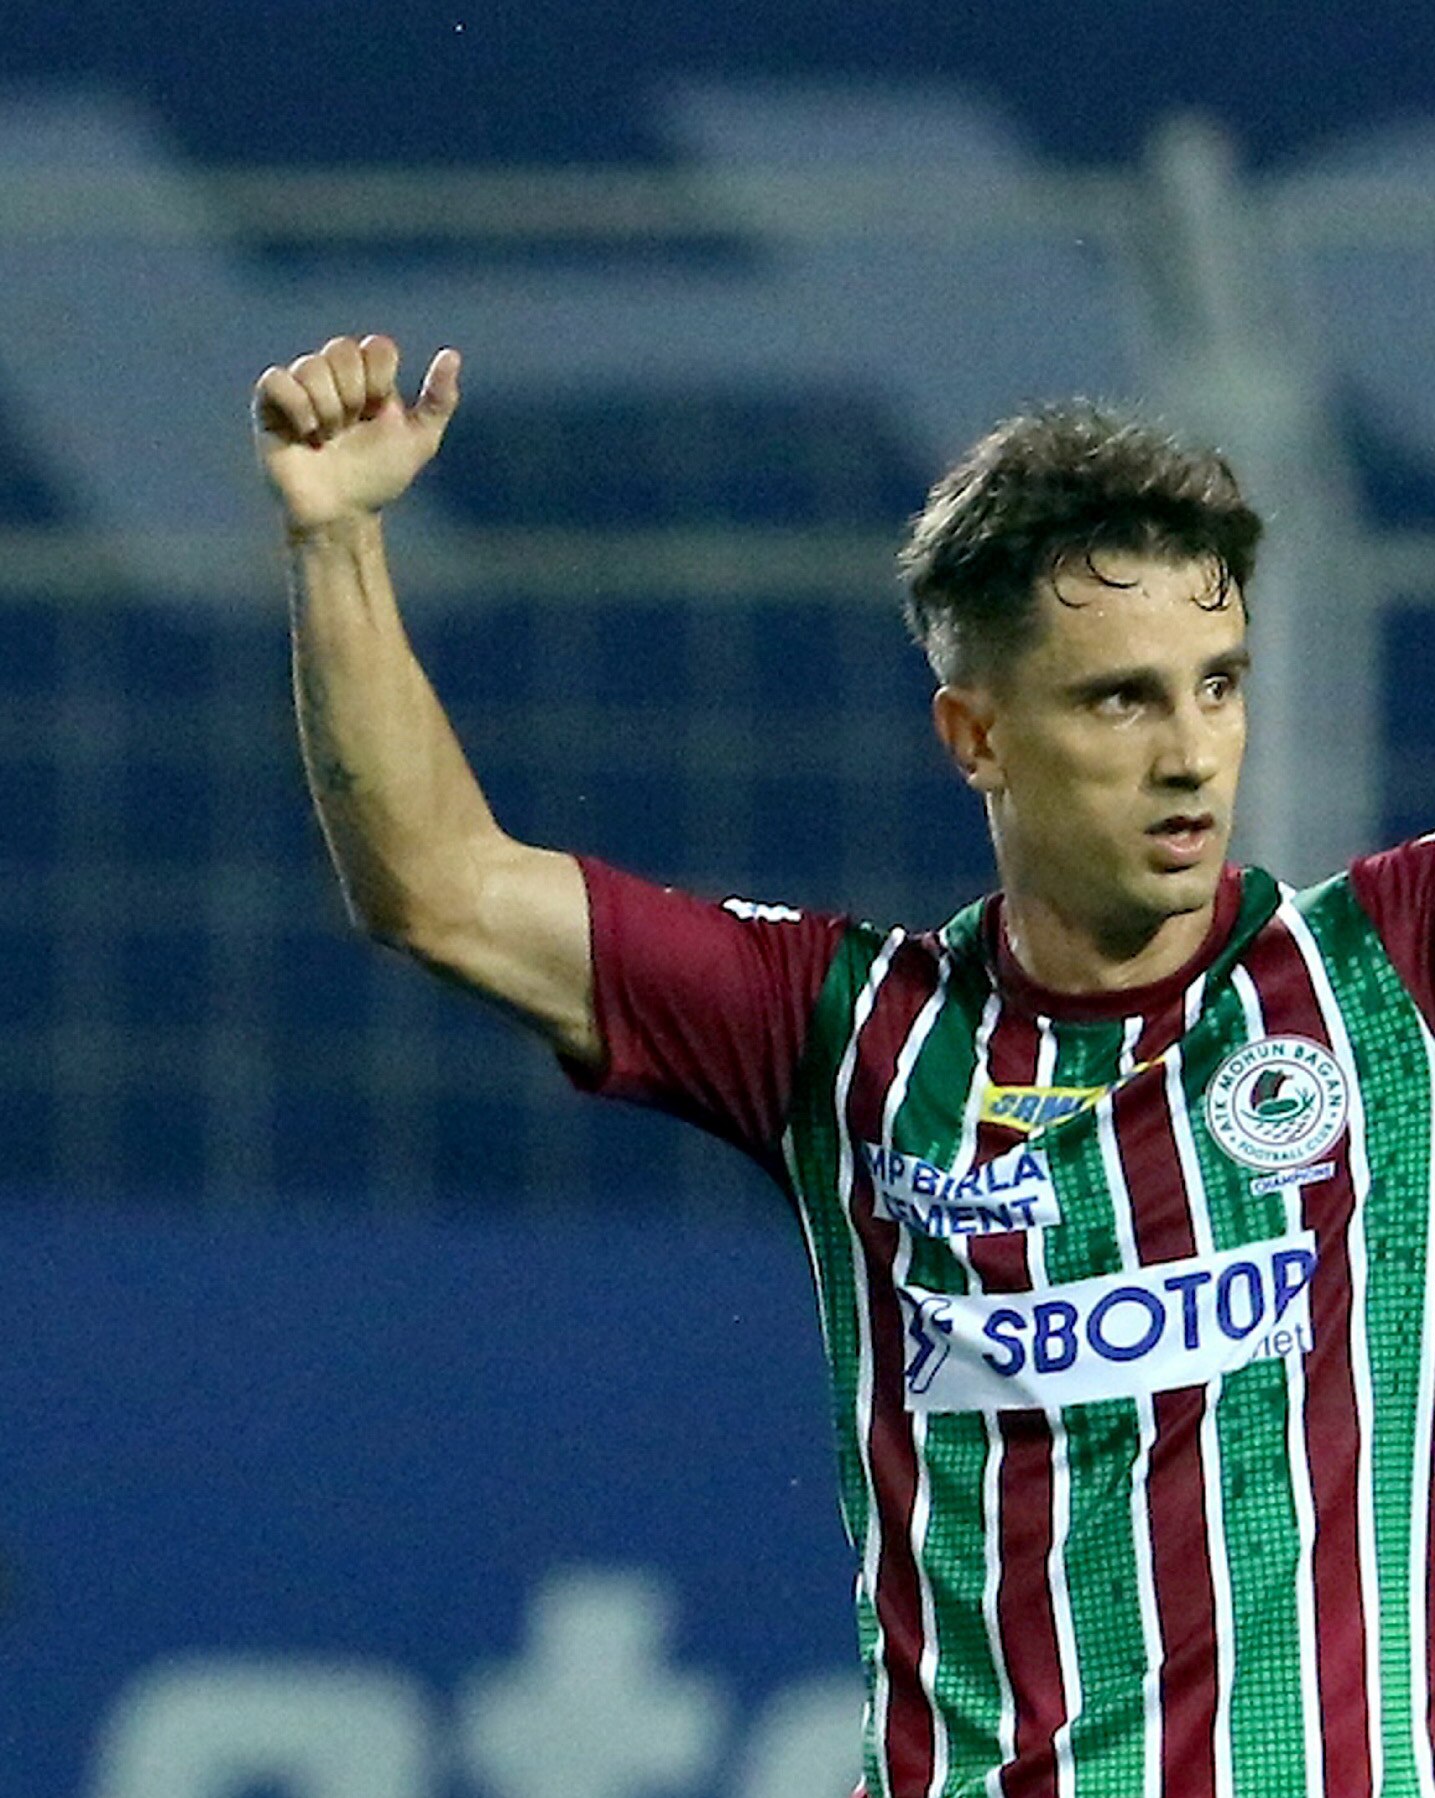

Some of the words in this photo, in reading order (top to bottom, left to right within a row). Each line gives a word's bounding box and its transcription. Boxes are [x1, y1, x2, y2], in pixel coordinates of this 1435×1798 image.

[1219, 1043, 1285, 1092] MOHUN
[1294, 1045, 1342, 1108] BAGAN
[913, 1153, 1047, 1201] BIRLA
[983, 1249, 1318, 1378] SBOTOP
